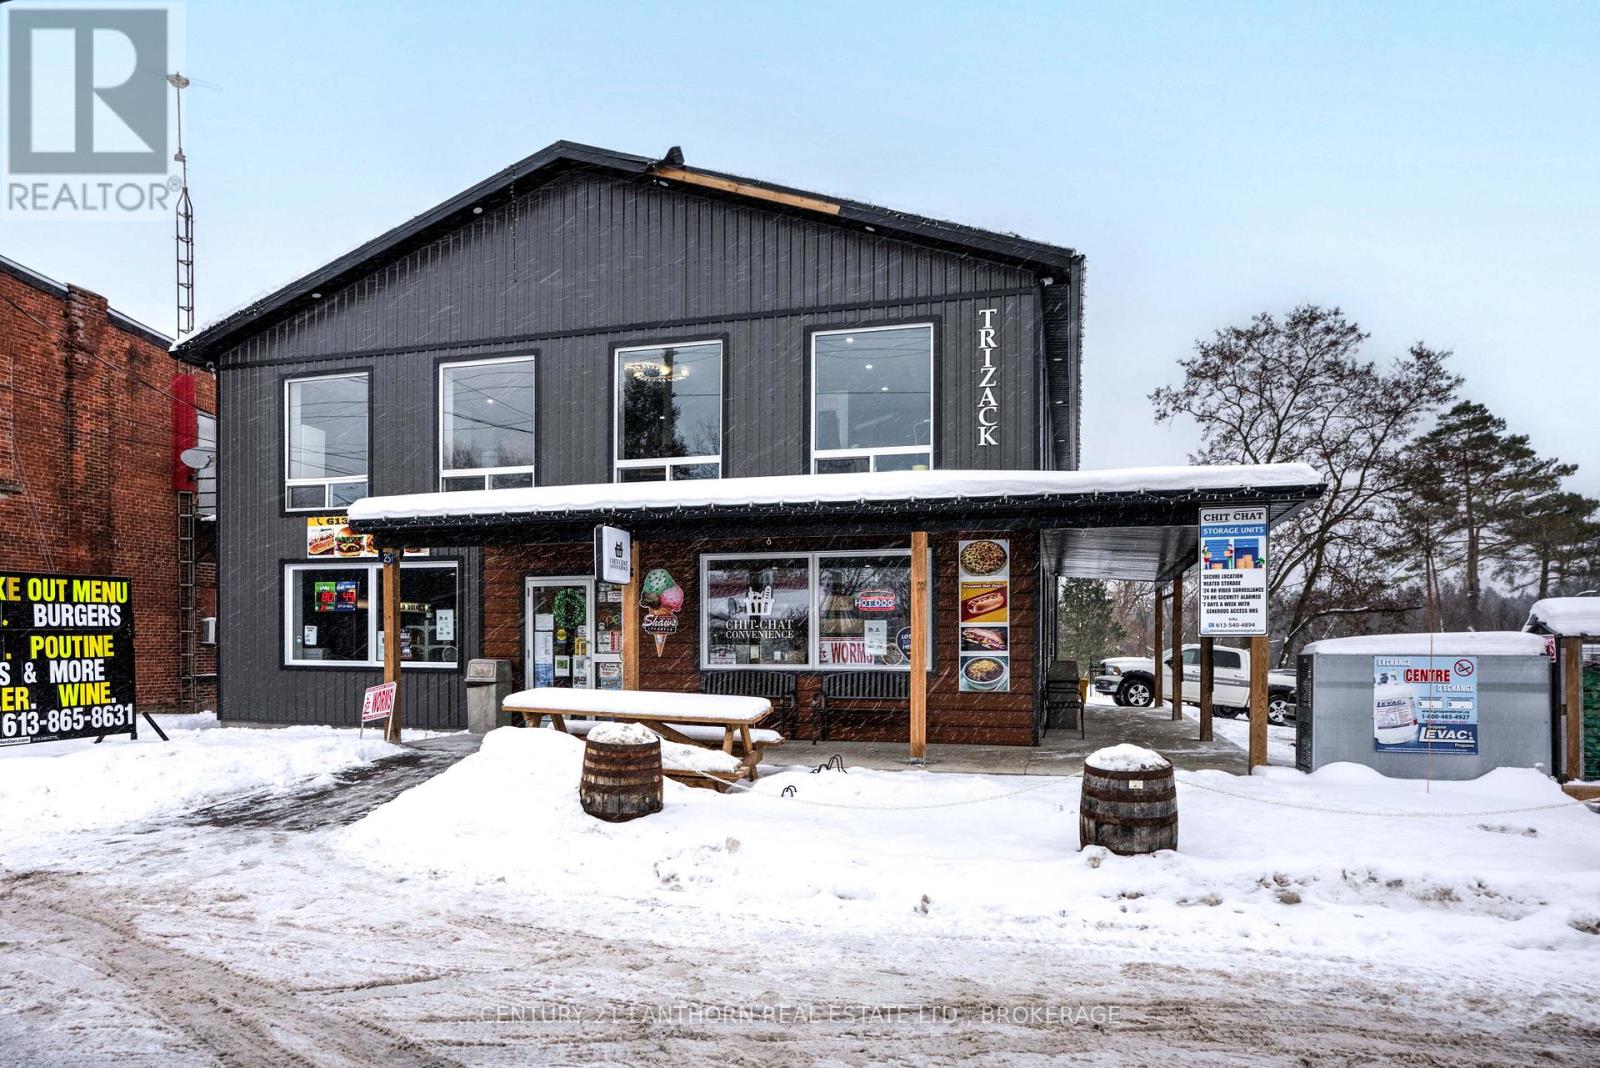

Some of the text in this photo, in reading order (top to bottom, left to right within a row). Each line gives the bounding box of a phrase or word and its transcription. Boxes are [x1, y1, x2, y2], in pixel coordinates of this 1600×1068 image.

[978, 309, 998, 446] TRIZACK
[1203, 512, 1263, 521] CHIT CHAT
[1203, 527, 1239, 535] STORAGE
[28, 578, 67, 602] OUT
[73, 580, 128, 603] MENU
[33, 603, 121, 627] BURGERS
[855, 599, 894, 607] HOT DOG
[725, 619, 794, 630] CHIT-CHAT
[725, 630, 794, 639] CONVENIENCE
[30, 635, 114, 660] POUTINE
[24, 661, 37, 684] &
[50, 659, 105, 683] MORE
[1405, 669, 1451, 683] CENTRE
[0, 686, 37, 712] ER.
[3, 703, 134, 737] 613-865-8631
